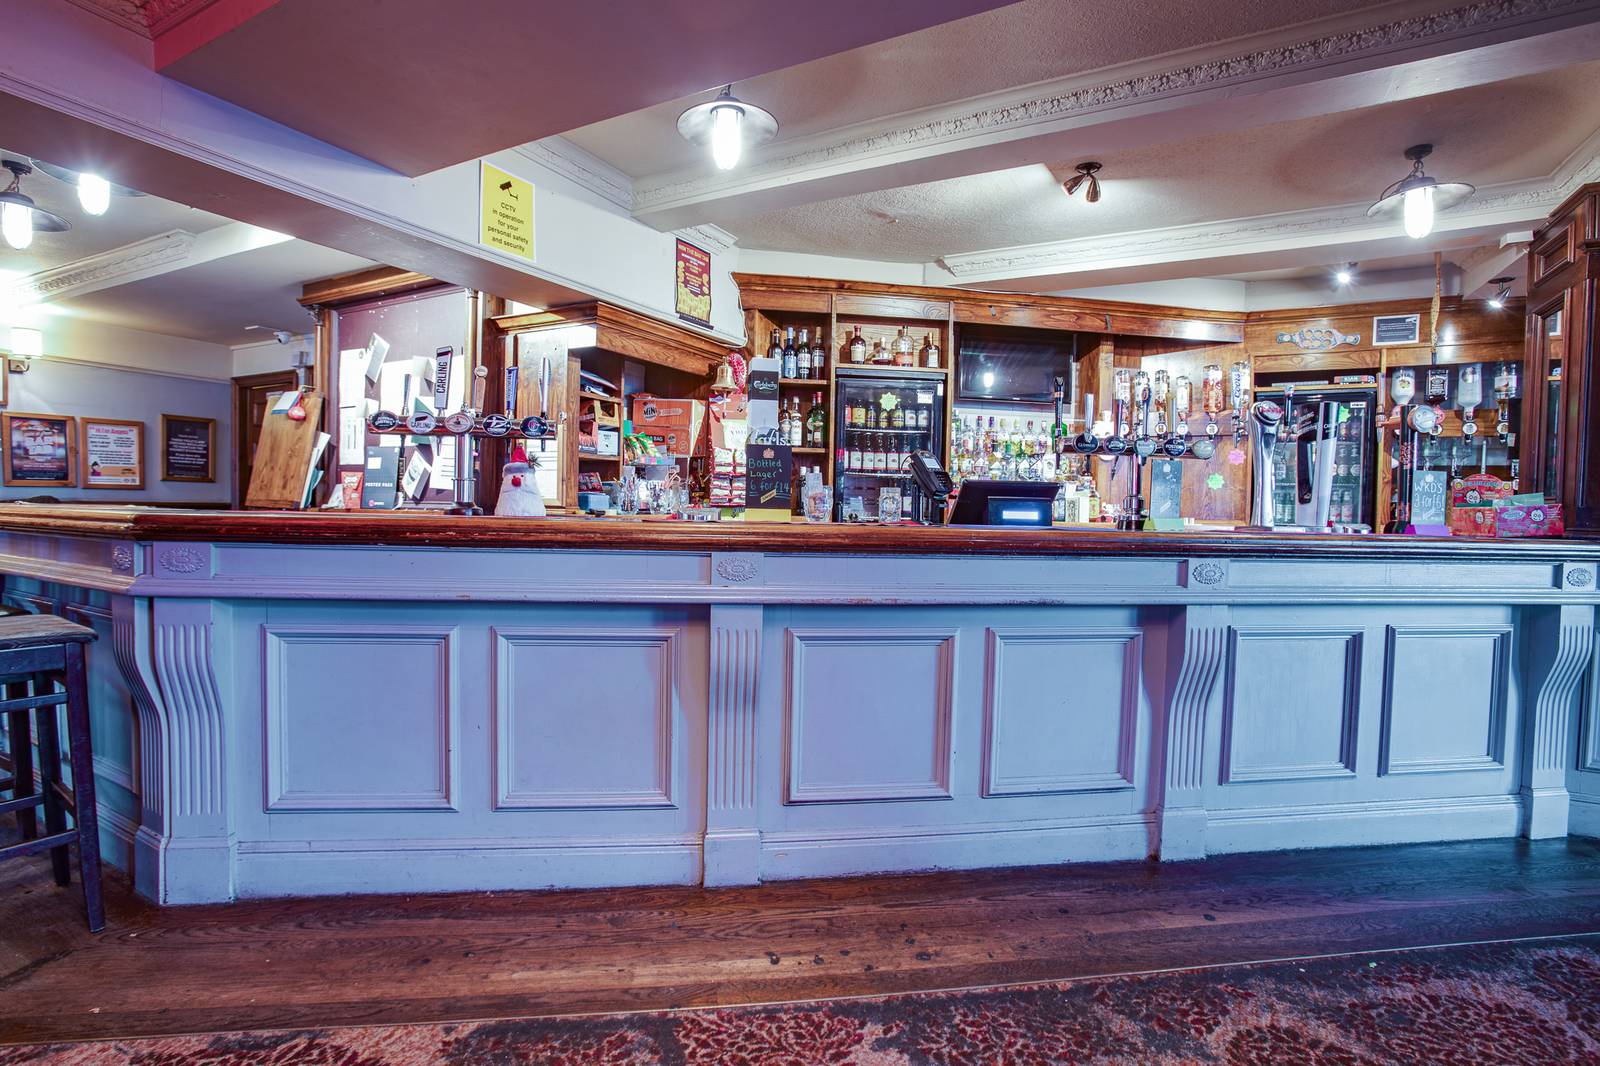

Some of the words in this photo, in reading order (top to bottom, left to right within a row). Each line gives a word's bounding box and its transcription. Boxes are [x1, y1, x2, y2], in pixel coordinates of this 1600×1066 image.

[500, 202, 516, 212] CCTV
[498, 212, 524, 224] operation
[507, 224, 518, 232] your
[488, 226, 512, 238] personal
[512, 234, 528, 245] safety
[504, 240, 524, 252] security
[436, 361, 448, 394] CARLING
[754, 380, 778, 390] Carlsberg
[748, 458, 782, 468] Bottled
[750, 470, 776, 480] Lager
